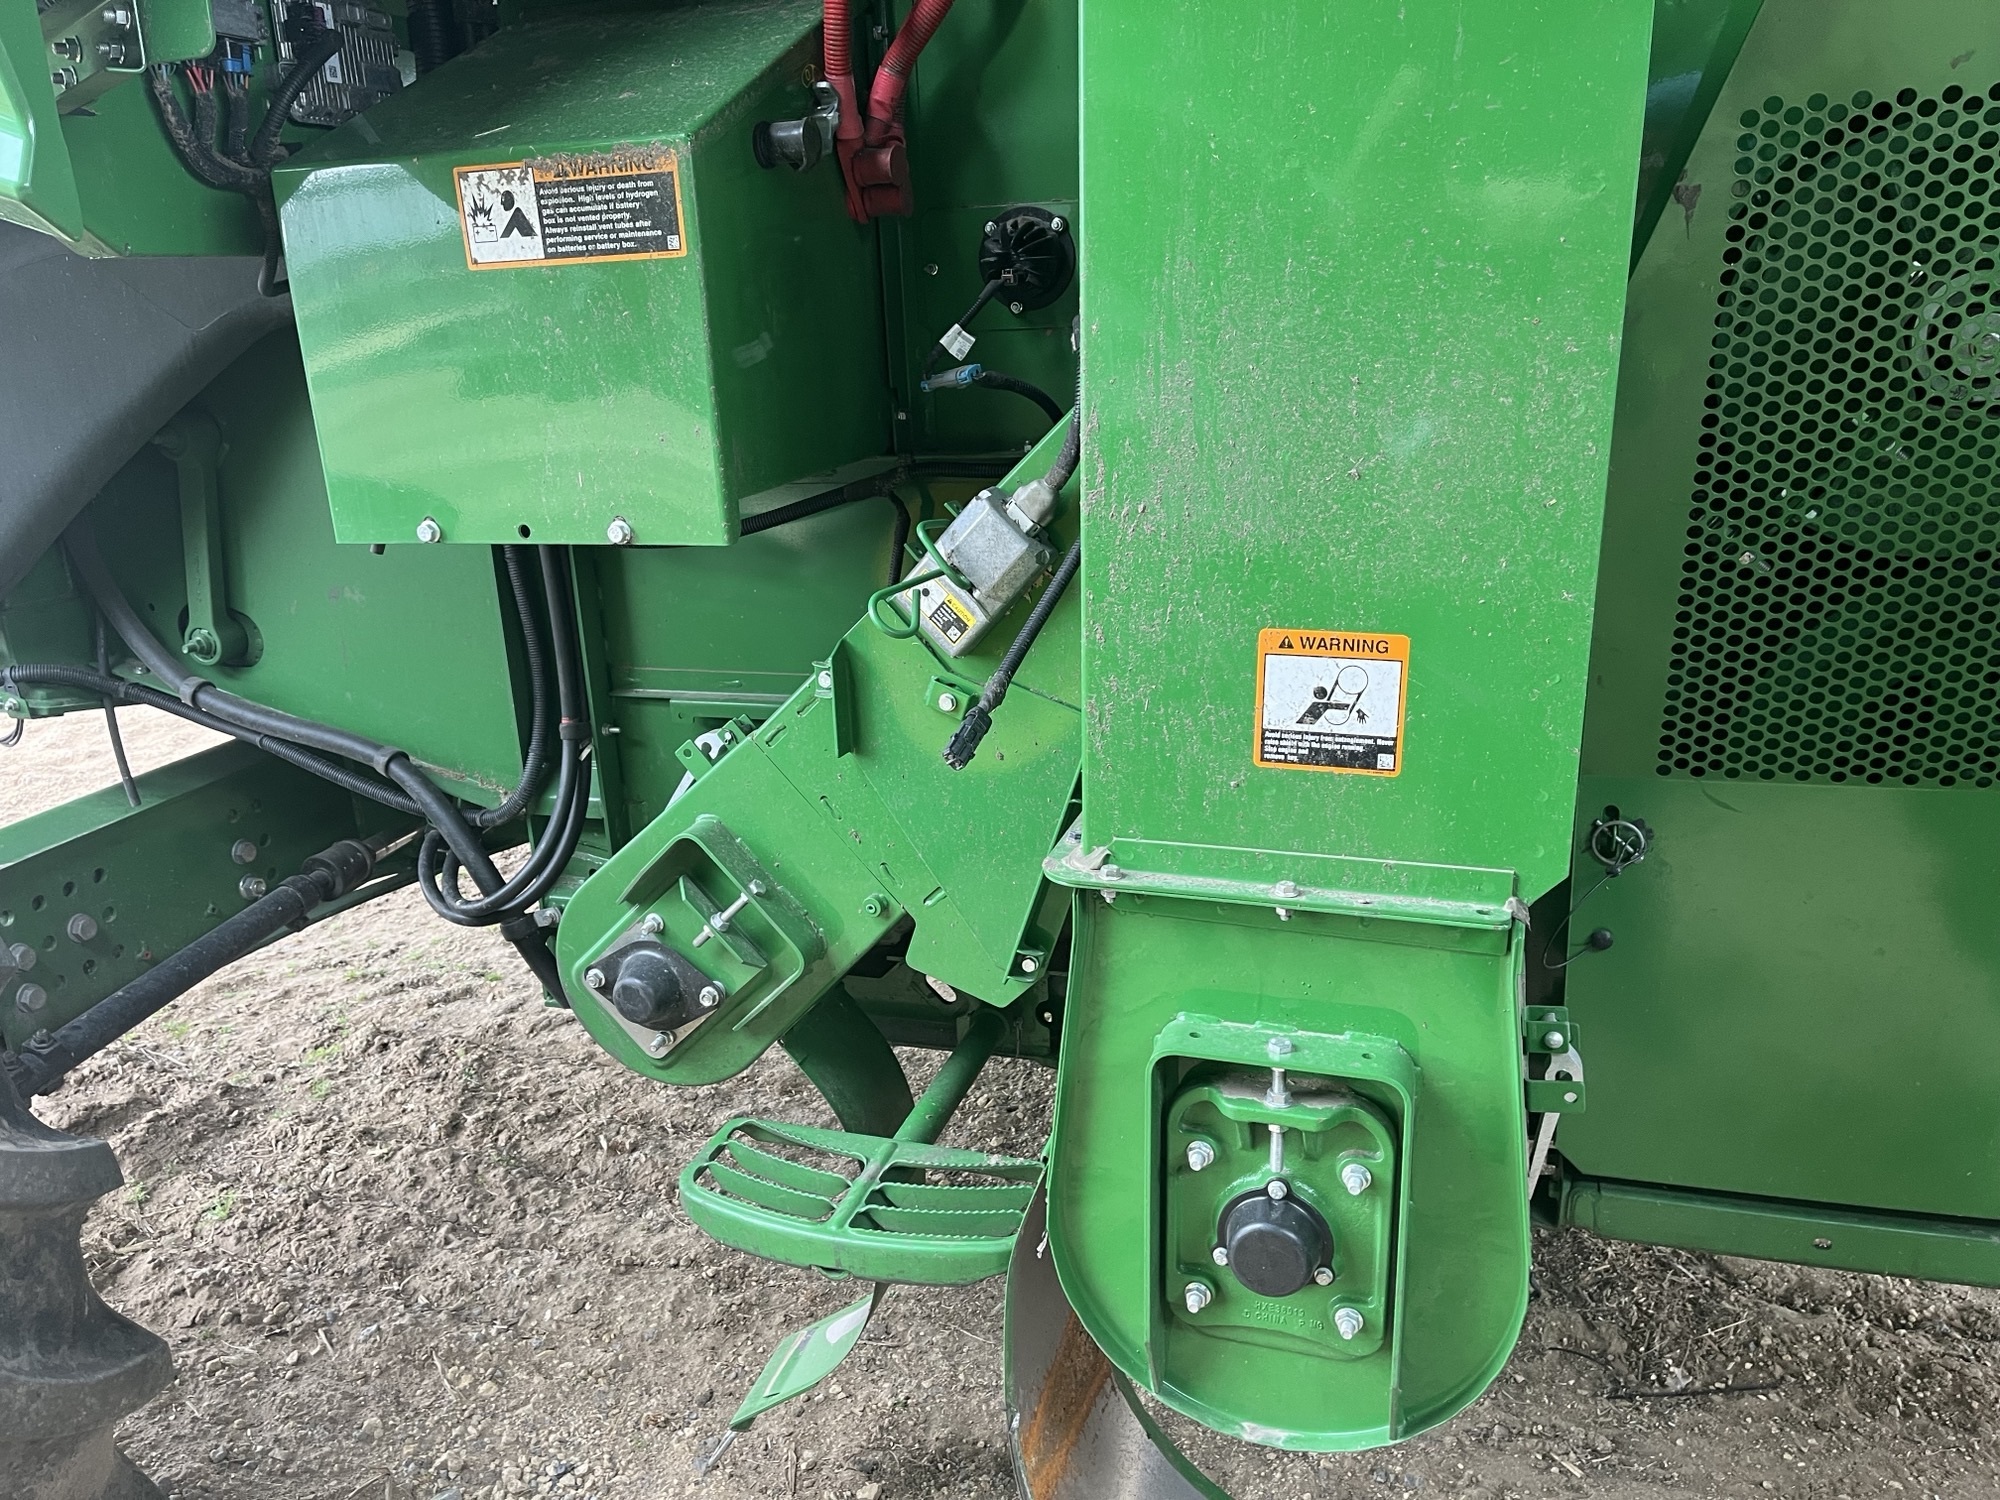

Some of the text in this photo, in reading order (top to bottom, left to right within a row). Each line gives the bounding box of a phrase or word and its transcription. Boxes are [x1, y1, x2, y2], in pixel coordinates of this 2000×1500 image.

[540, 187, 558, 196] Avoid
[586, 184, 605, 192] injury
[578, 194, 594, 203] High
[595, 192, 615, 200] levels
[626, 188, 658, 200] hydrogen
[541, 208, 554, 216] gas
[569, 203, 608, 212] accumulate
[616, 201, 640, 212] battery
[578, 213, 600, 222] vented
[602, 212, 632, 221] properly.
[545, 226, 568, 235] Always
[570, 223, 597, 232] reinstall
[615, 220, 634, 229] tubes
[546, 235, 582, 245] performing
[584, 232, 608, 241] service
[618, 230, 662, 238] maintenance
[557, 243, 586, 252] batteries
[596, 241, 620, 250] battery
[952, 603, 971, 622] CAUTION
[1300, 636, 1389, 654] WARNING
[1303, 733, 1320, 742] injury
[1255, 1311, 1287, 1325] CHINA
